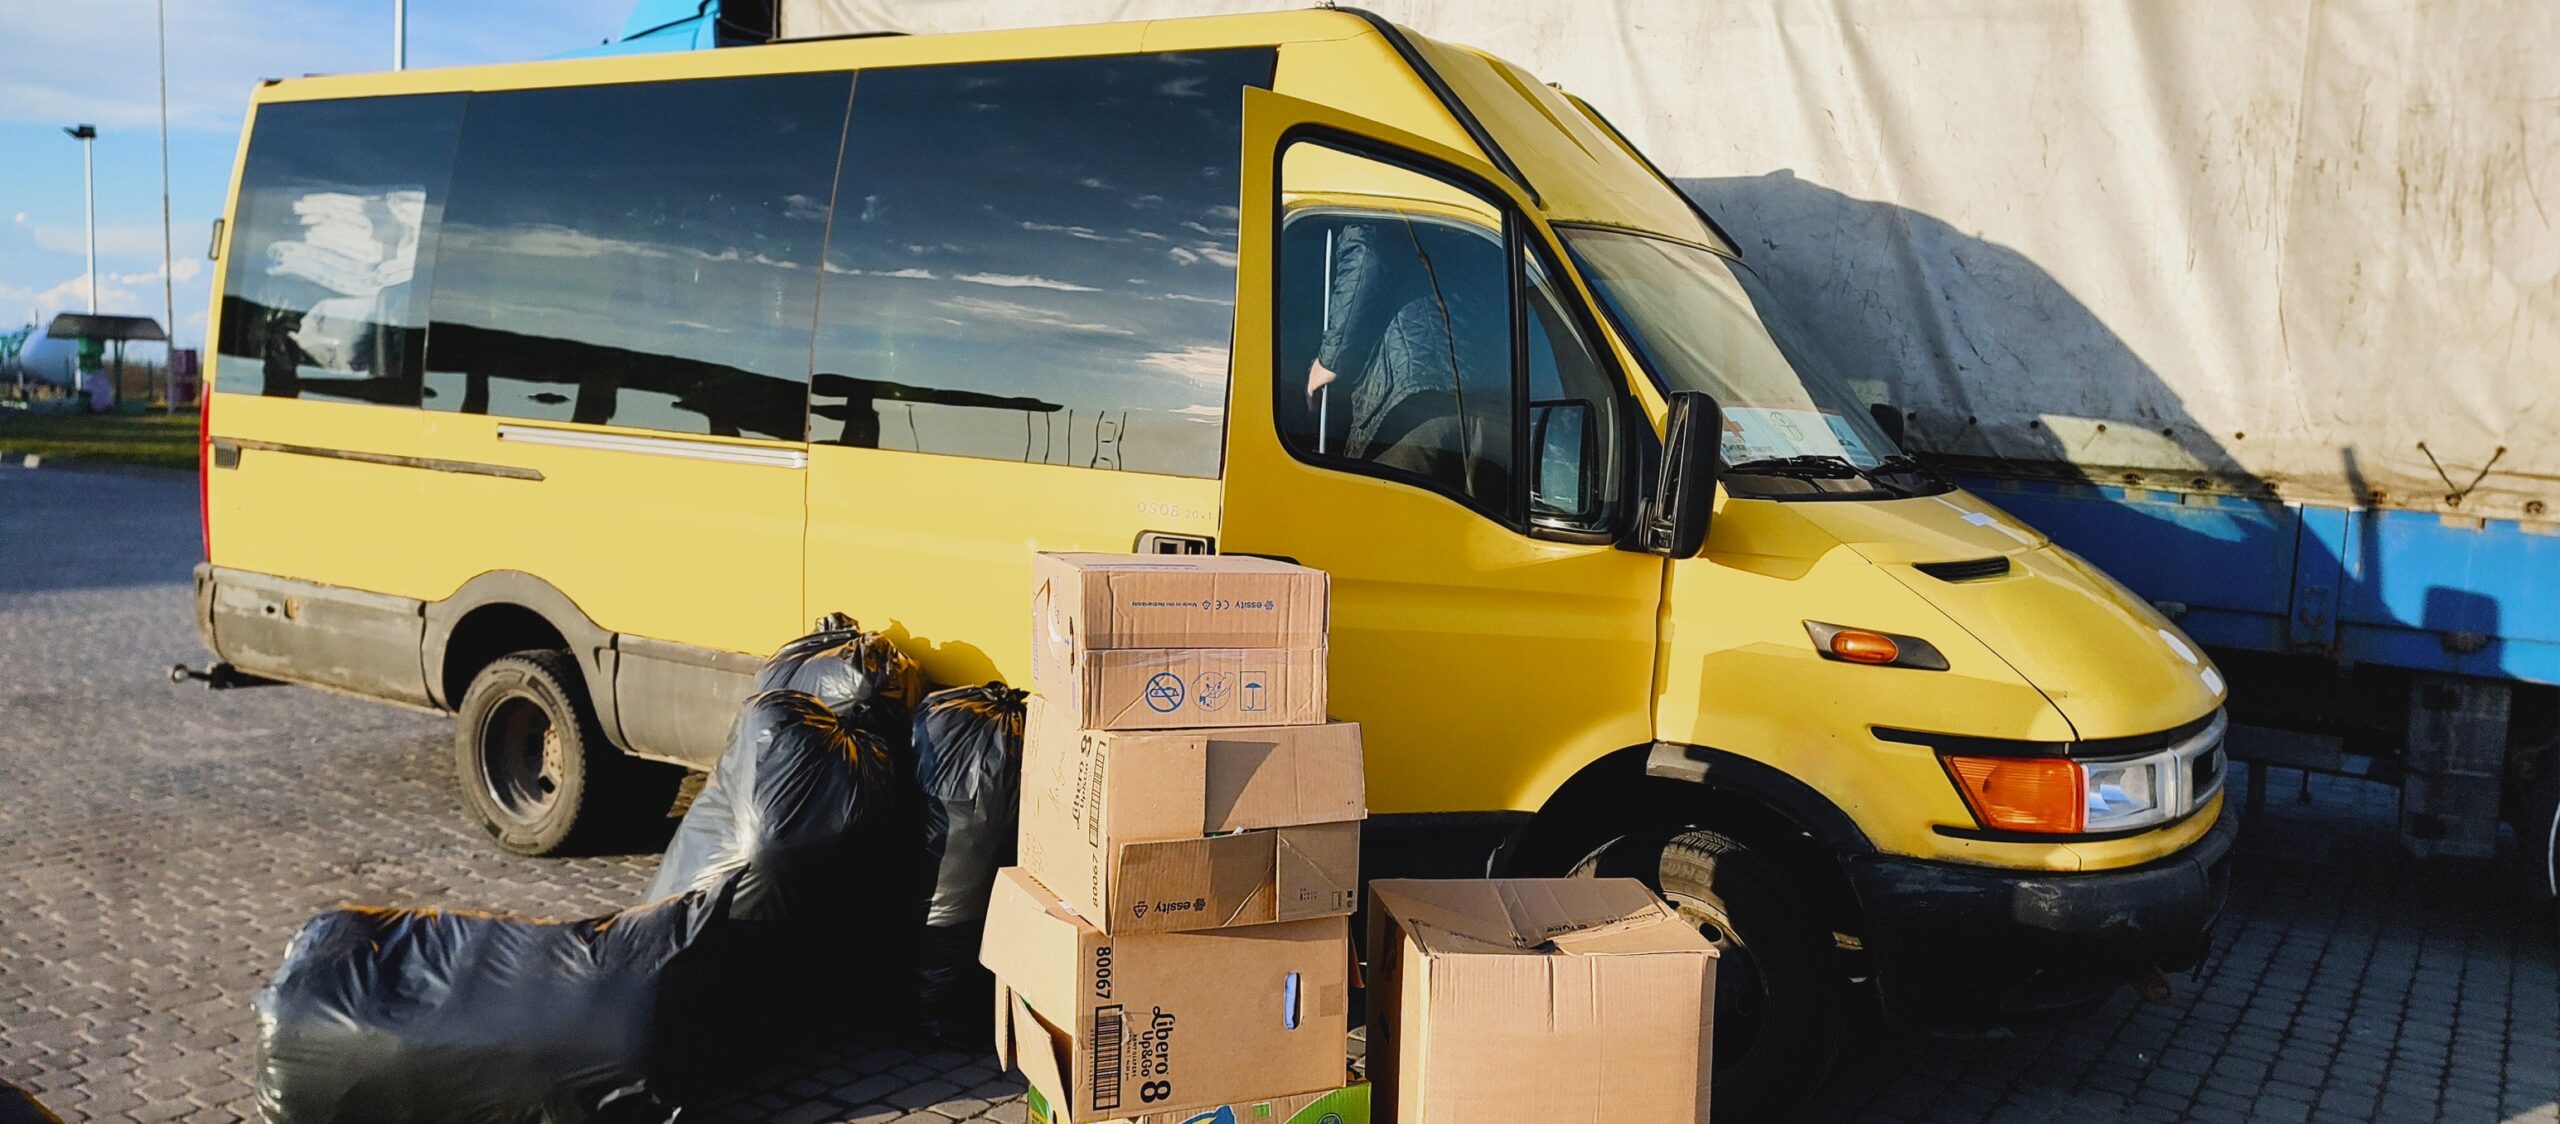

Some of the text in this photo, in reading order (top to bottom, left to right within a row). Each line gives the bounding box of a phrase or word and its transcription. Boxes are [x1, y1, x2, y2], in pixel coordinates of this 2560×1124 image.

[1137, 501, 1180, 518] OSOB
[1235, 600, 1263, 611] essity
[1071, 760, 1084, 831] Libero
[1091, 853, 1101, 908] 80067
[1153, 901, 1191, 914] essity
[1096, 946, 1111, 999] 80067
[1138, 1030, 1154, 1078] Up&Go
[1140, 1005, 1176, 1103] Libero 8
